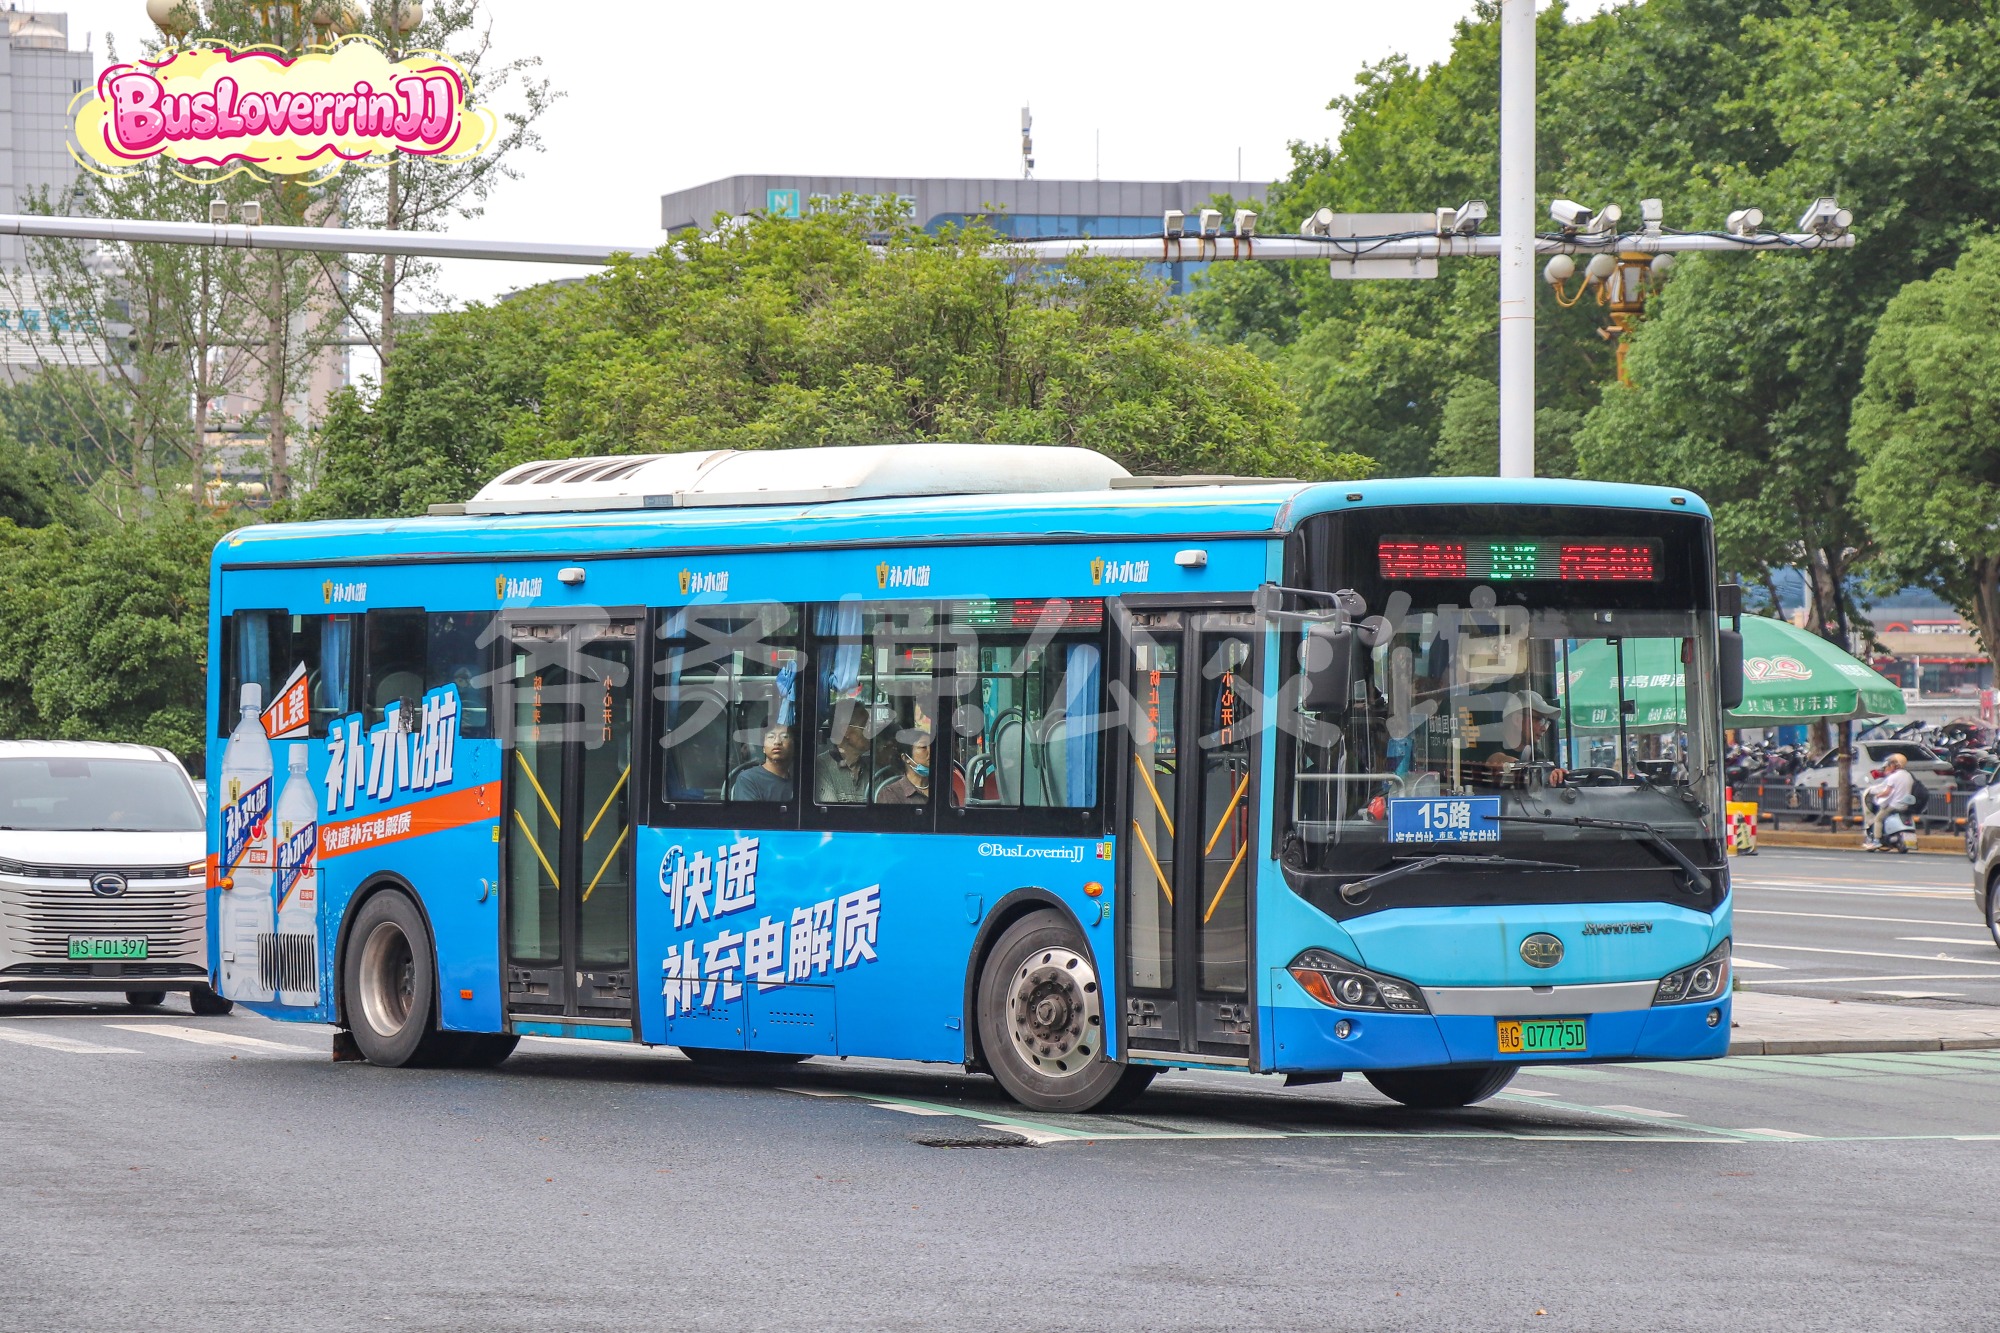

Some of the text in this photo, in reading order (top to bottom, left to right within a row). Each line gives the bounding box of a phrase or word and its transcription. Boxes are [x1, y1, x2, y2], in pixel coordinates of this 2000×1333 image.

[507, 577, 543, 598] 补水啦
[690, 569, 729, 592] 补水啦
[889, 565, 931, 588] 补水啦
[1105, 560, 1149, 584] 补水啦
[333, 582, 367, 603] 补水啦
[270, 684, 305, 735] 1L装
[324, 690, 457, 813] 补水啦
[225, 783, 267, 850] 补水啦
[325, 811, 412, 852] 快速补充电解质
[1417, 801, 1472, 829] 15路
[280, 824, 314, 880] 补水啦
[668, 835, 760, 928] 快速
[661, 883, 882, 1018] 补充电解质
[1527, 942, 1559, 956] BLK
